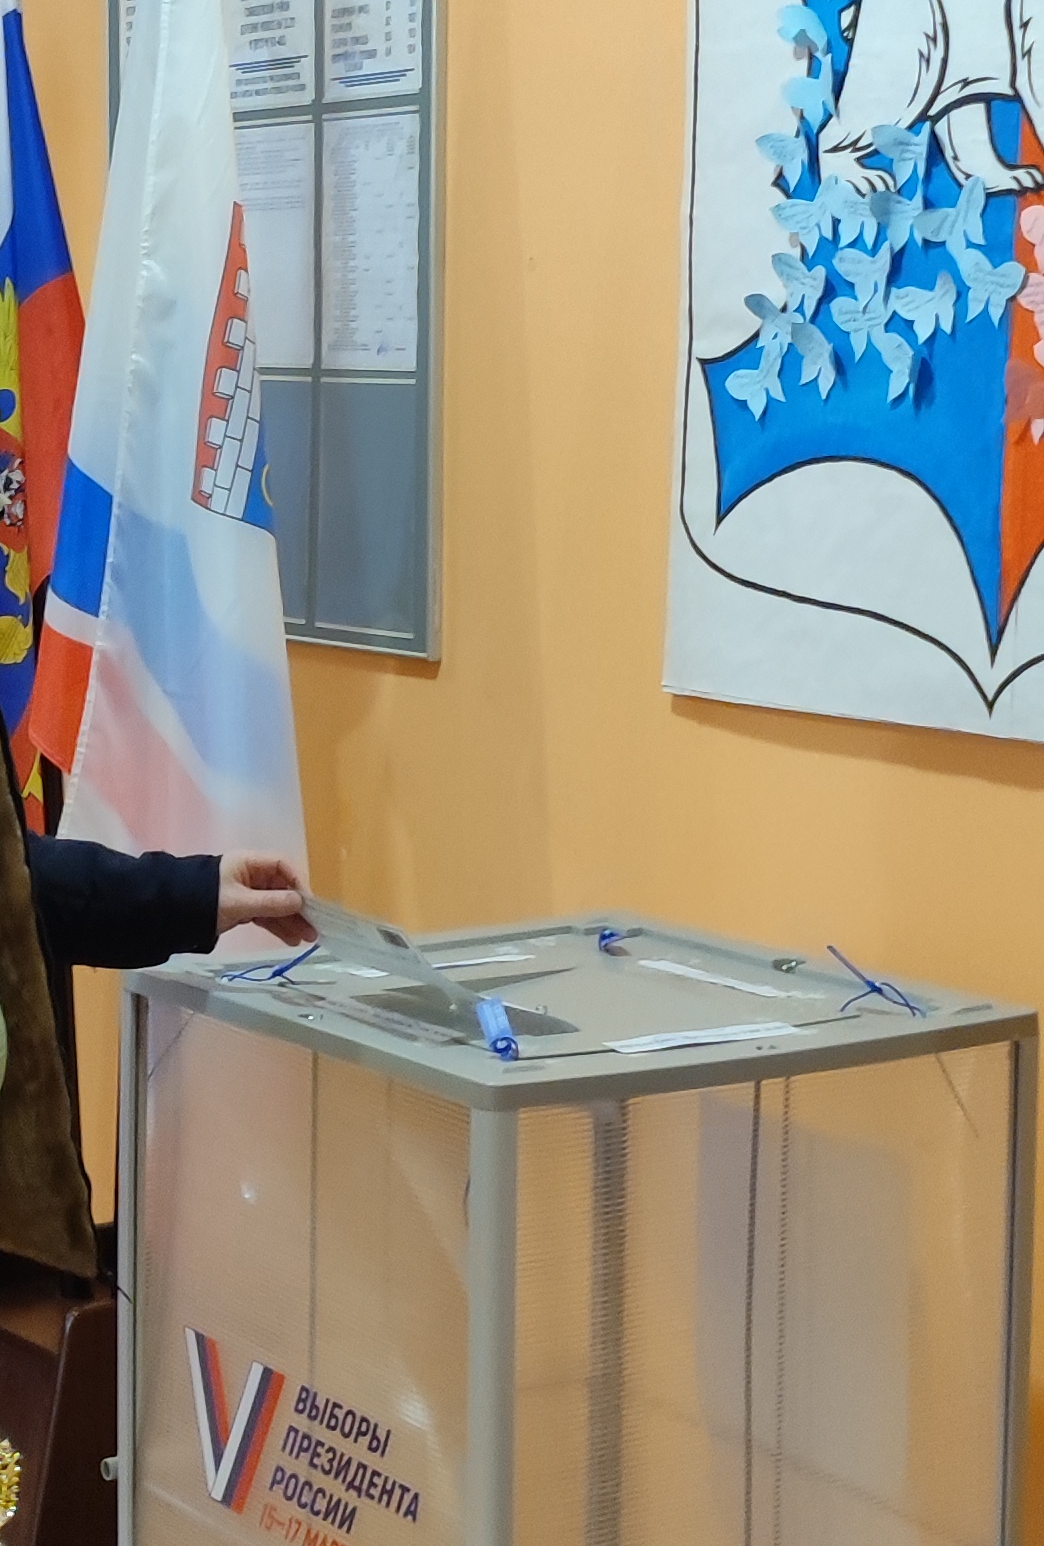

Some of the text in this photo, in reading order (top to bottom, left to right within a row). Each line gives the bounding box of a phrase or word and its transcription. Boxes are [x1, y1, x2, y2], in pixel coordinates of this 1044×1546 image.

[294, 1384, 392, 1458] ВЫБОРЫ
[269, 1464, 358, 1535] РОССИИ
[281, 1425, 422, 1524] ПРЕЗИДЕНТА
